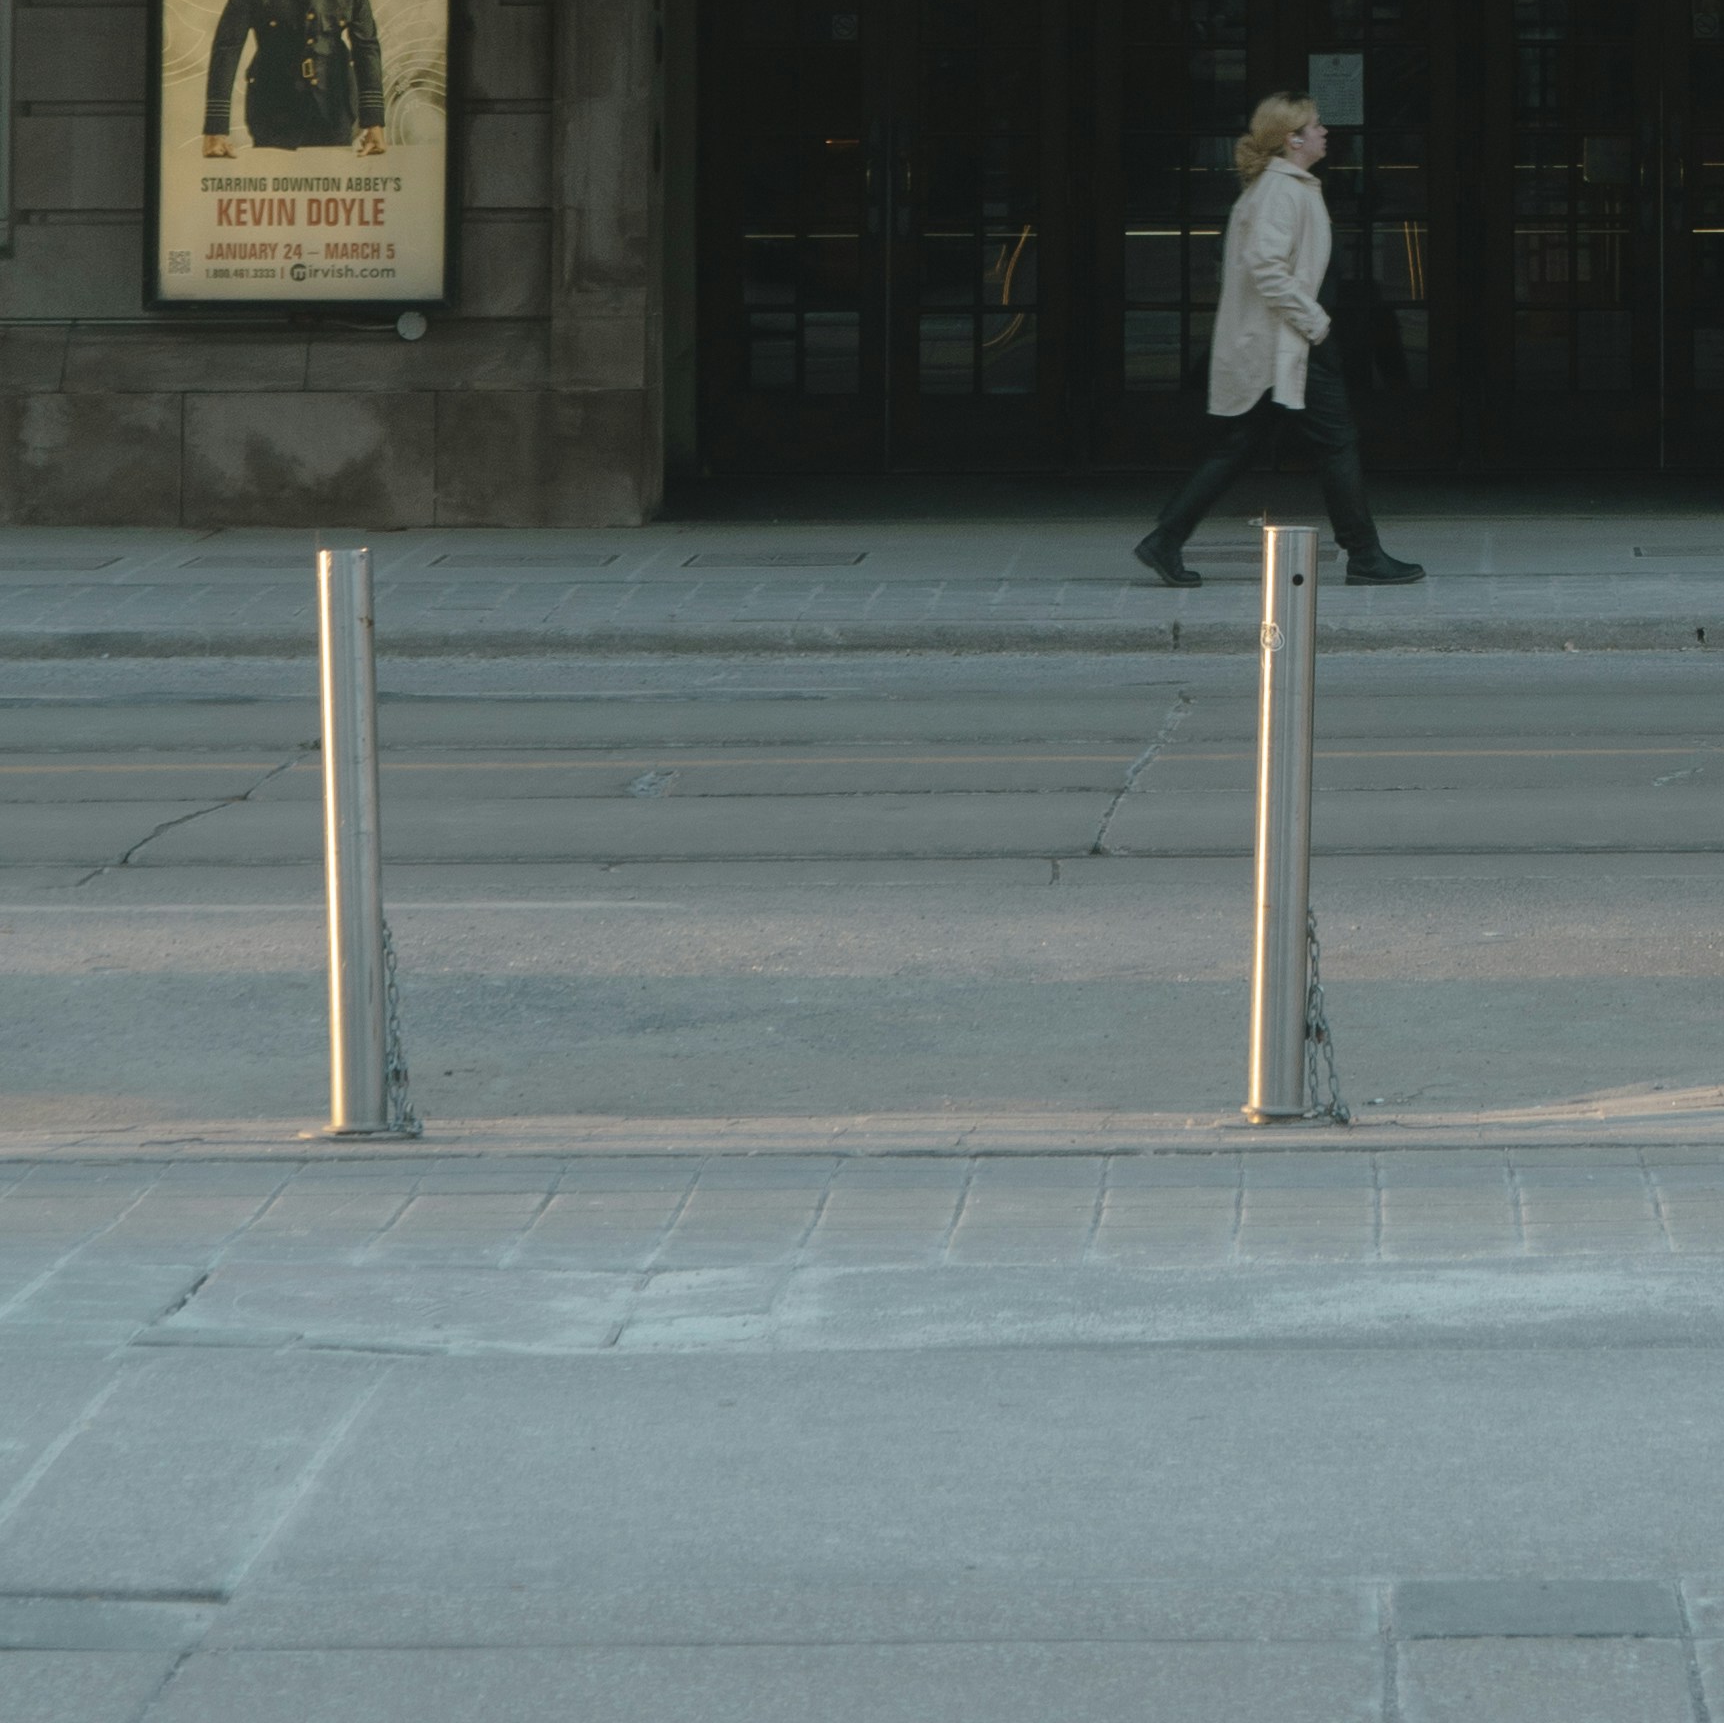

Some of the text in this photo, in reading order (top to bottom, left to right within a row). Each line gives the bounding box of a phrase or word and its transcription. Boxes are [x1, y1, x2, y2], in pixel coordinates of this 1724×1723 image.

[201, 177, 402, 193] STARRING DOWNTON ABBEY'S
[216, 197, 385, 227] KEVIN DOYLE
[205, 242, 279, 261] JANUARY
[284, 242, 303, 261] 24
[324, 242, 381, 261] MARCH
[385, 242, 396, 261] 5
